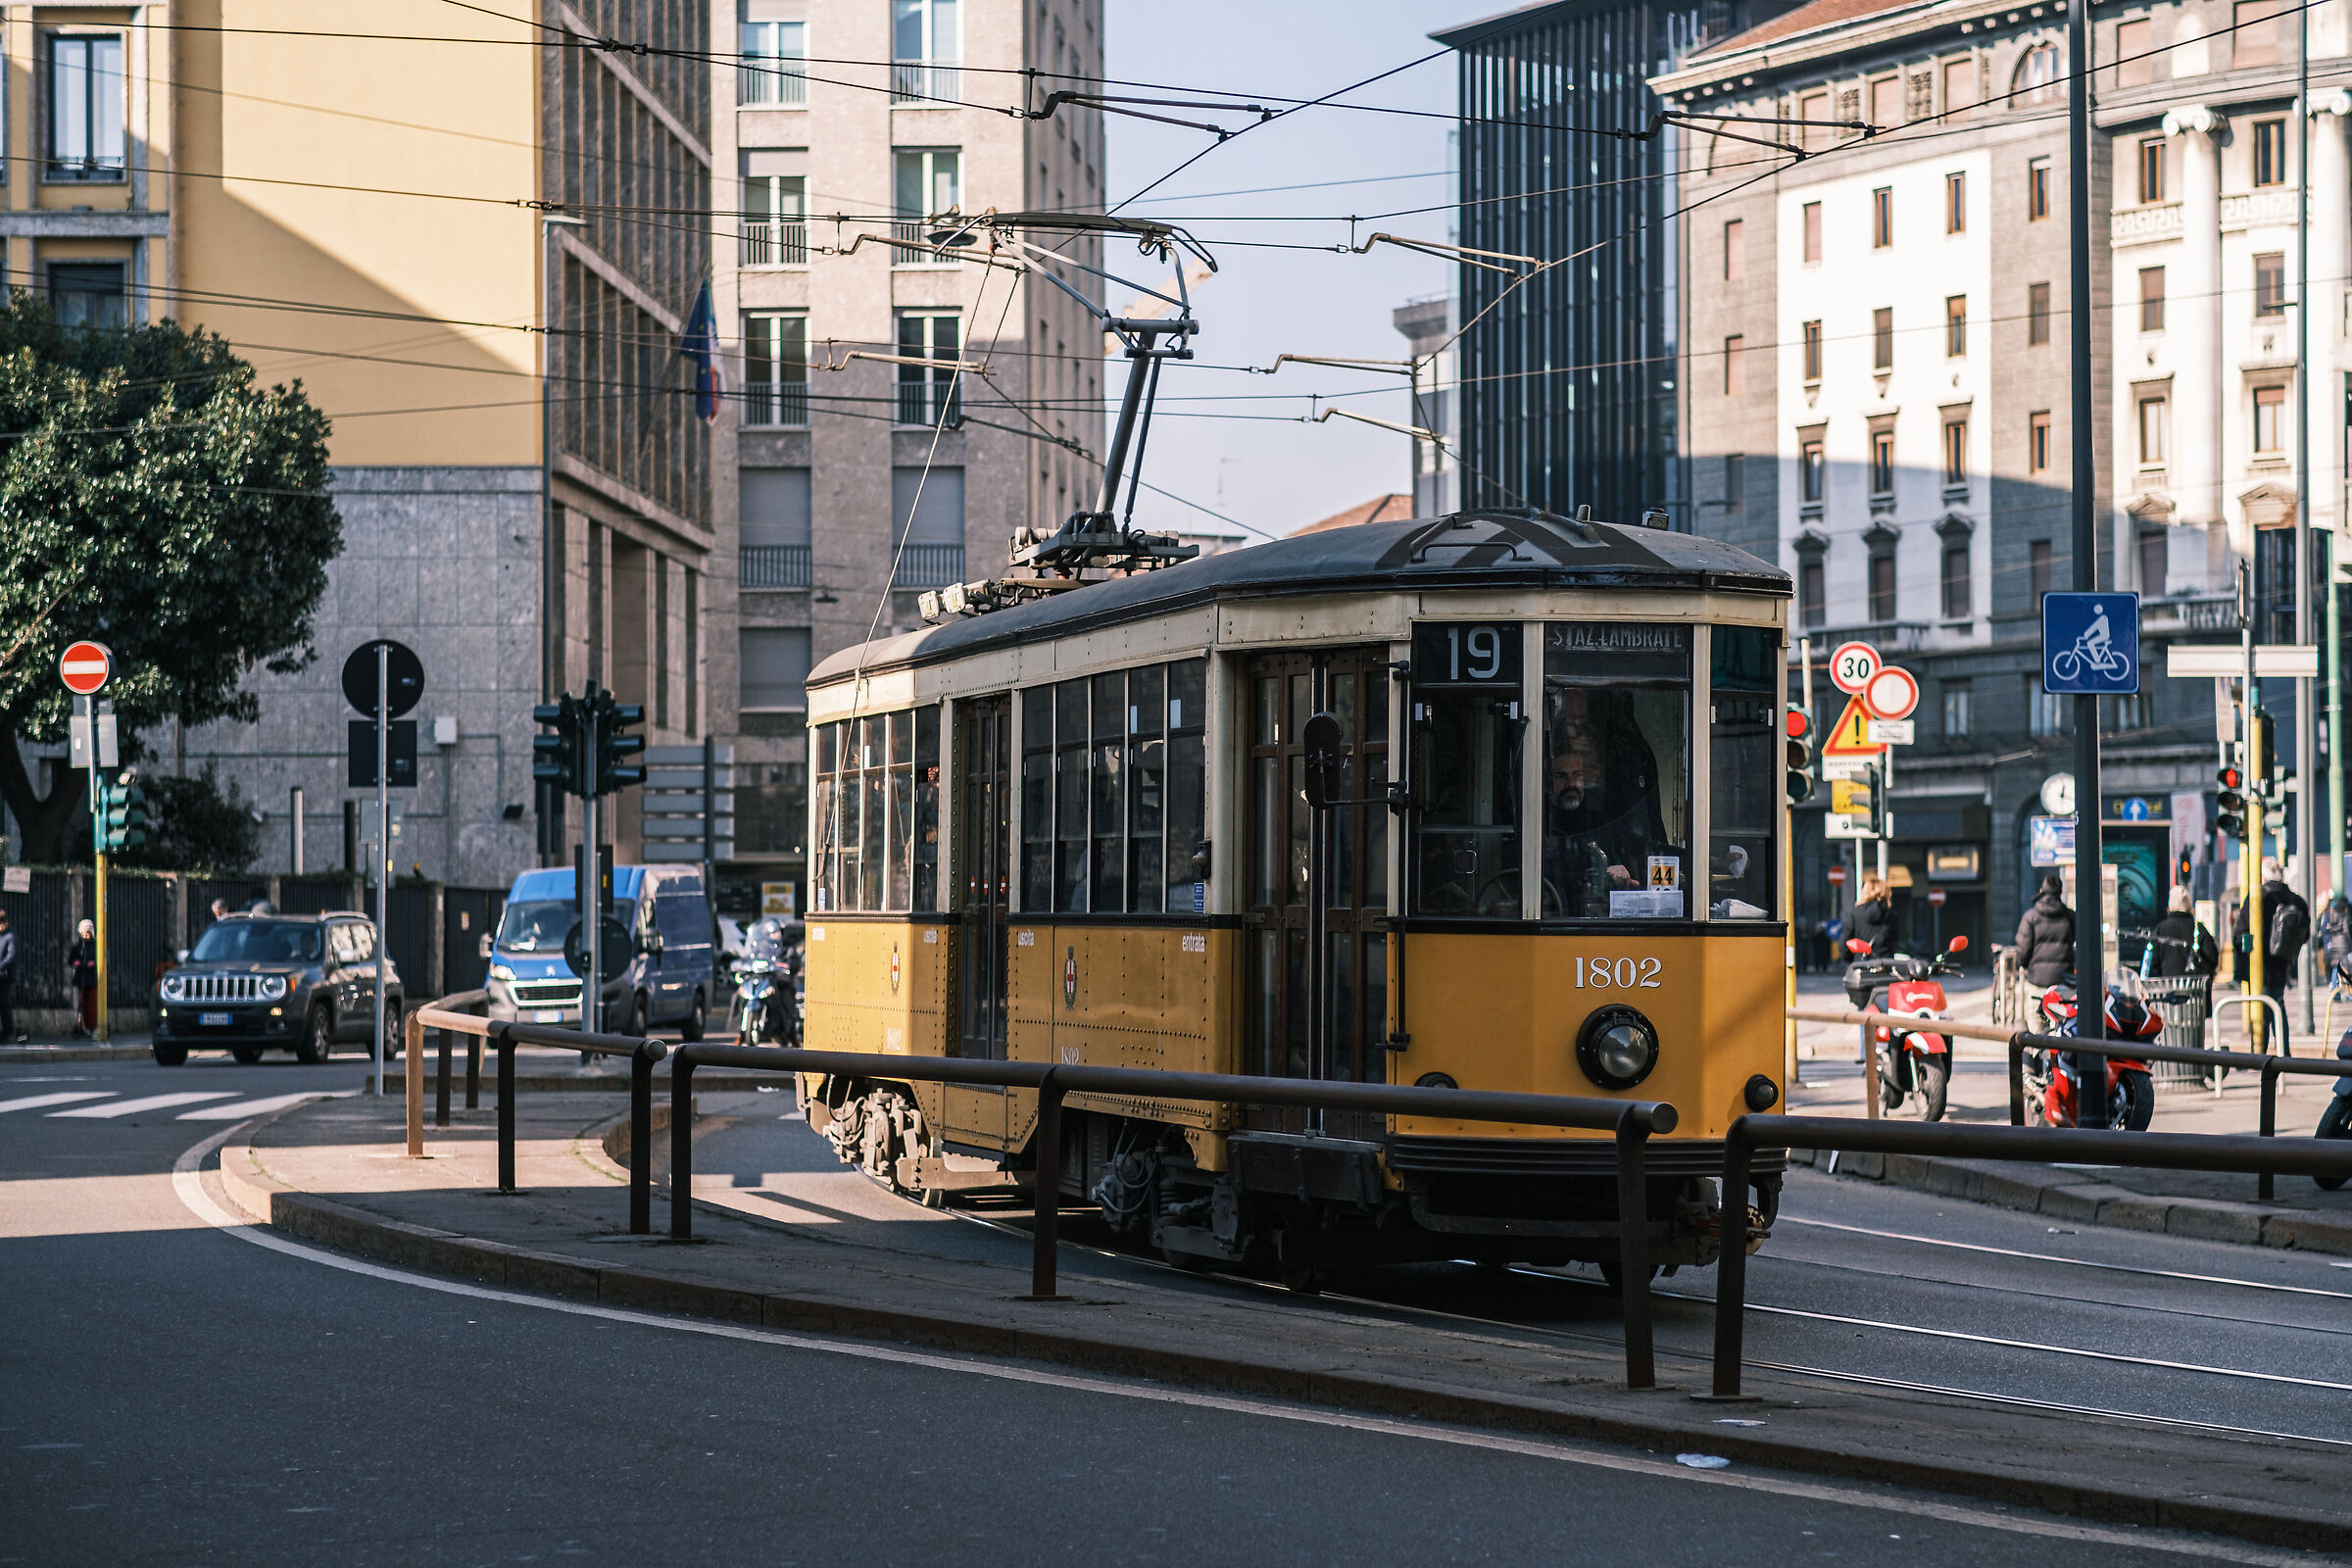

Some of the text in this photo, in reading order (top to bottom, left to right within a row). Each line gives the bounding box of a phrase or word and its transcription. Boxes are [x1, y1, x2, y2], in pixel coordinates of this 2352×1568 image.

[1447, 625, 1500, 680] 19
[1843, 658, 1870, 679] 30
[1652, 866, 1674, 885] 44
[1182, 931, 1205, 953] entrata
[1575, 956, 1663, 989] 1802
